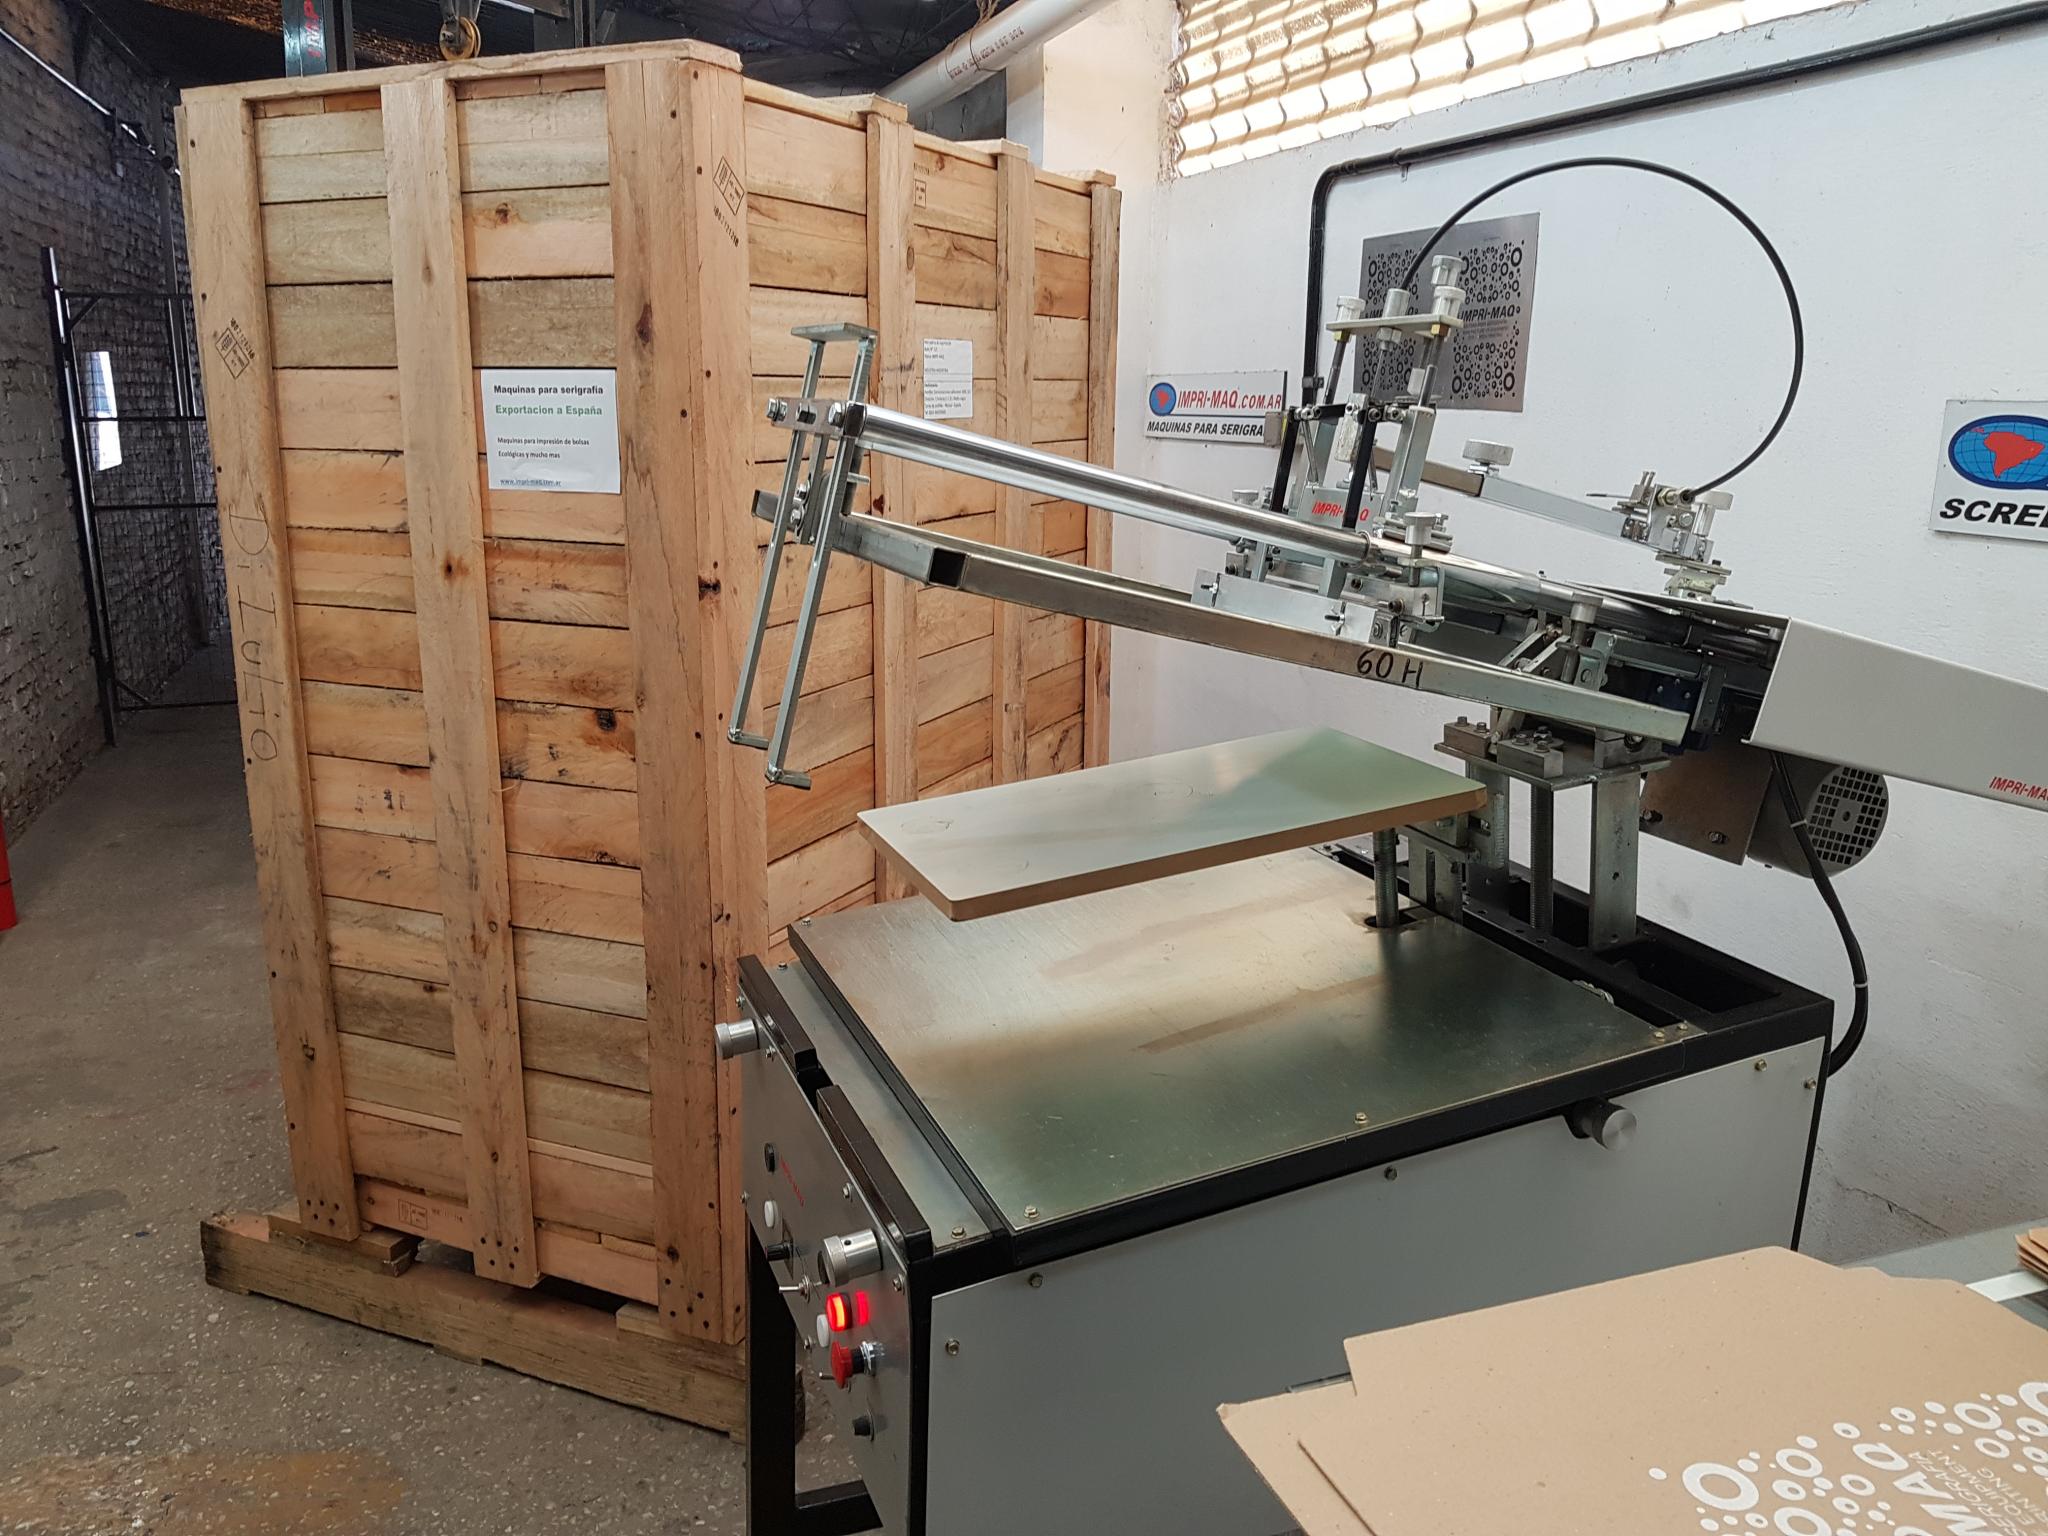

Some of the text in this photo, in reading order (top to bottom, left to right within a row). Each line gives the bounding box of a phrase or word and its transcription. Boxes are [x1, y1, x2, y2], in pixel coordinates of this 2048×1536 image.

[493, 385, 536, 395] Maquinas
[538, 386, 558, 396] para
[495, 404, 602, 416] Exportacion a España
[1147, 421, 1264, 437] MAQUINAS PARA SERIGRA
[497, 437, 523, 445] Maquinas
[572, 438, 589, 446] bolsas
[530, 451, 548, 459] mucho
[1312, 502, 1369, 521] IMPRI-Q
[1357, 648, 1424, 689] 60 H
[1989, 776, 2048, 801] IMPRI-MA
[1927, 1449, 2036, 1526] EQUIPMENT
